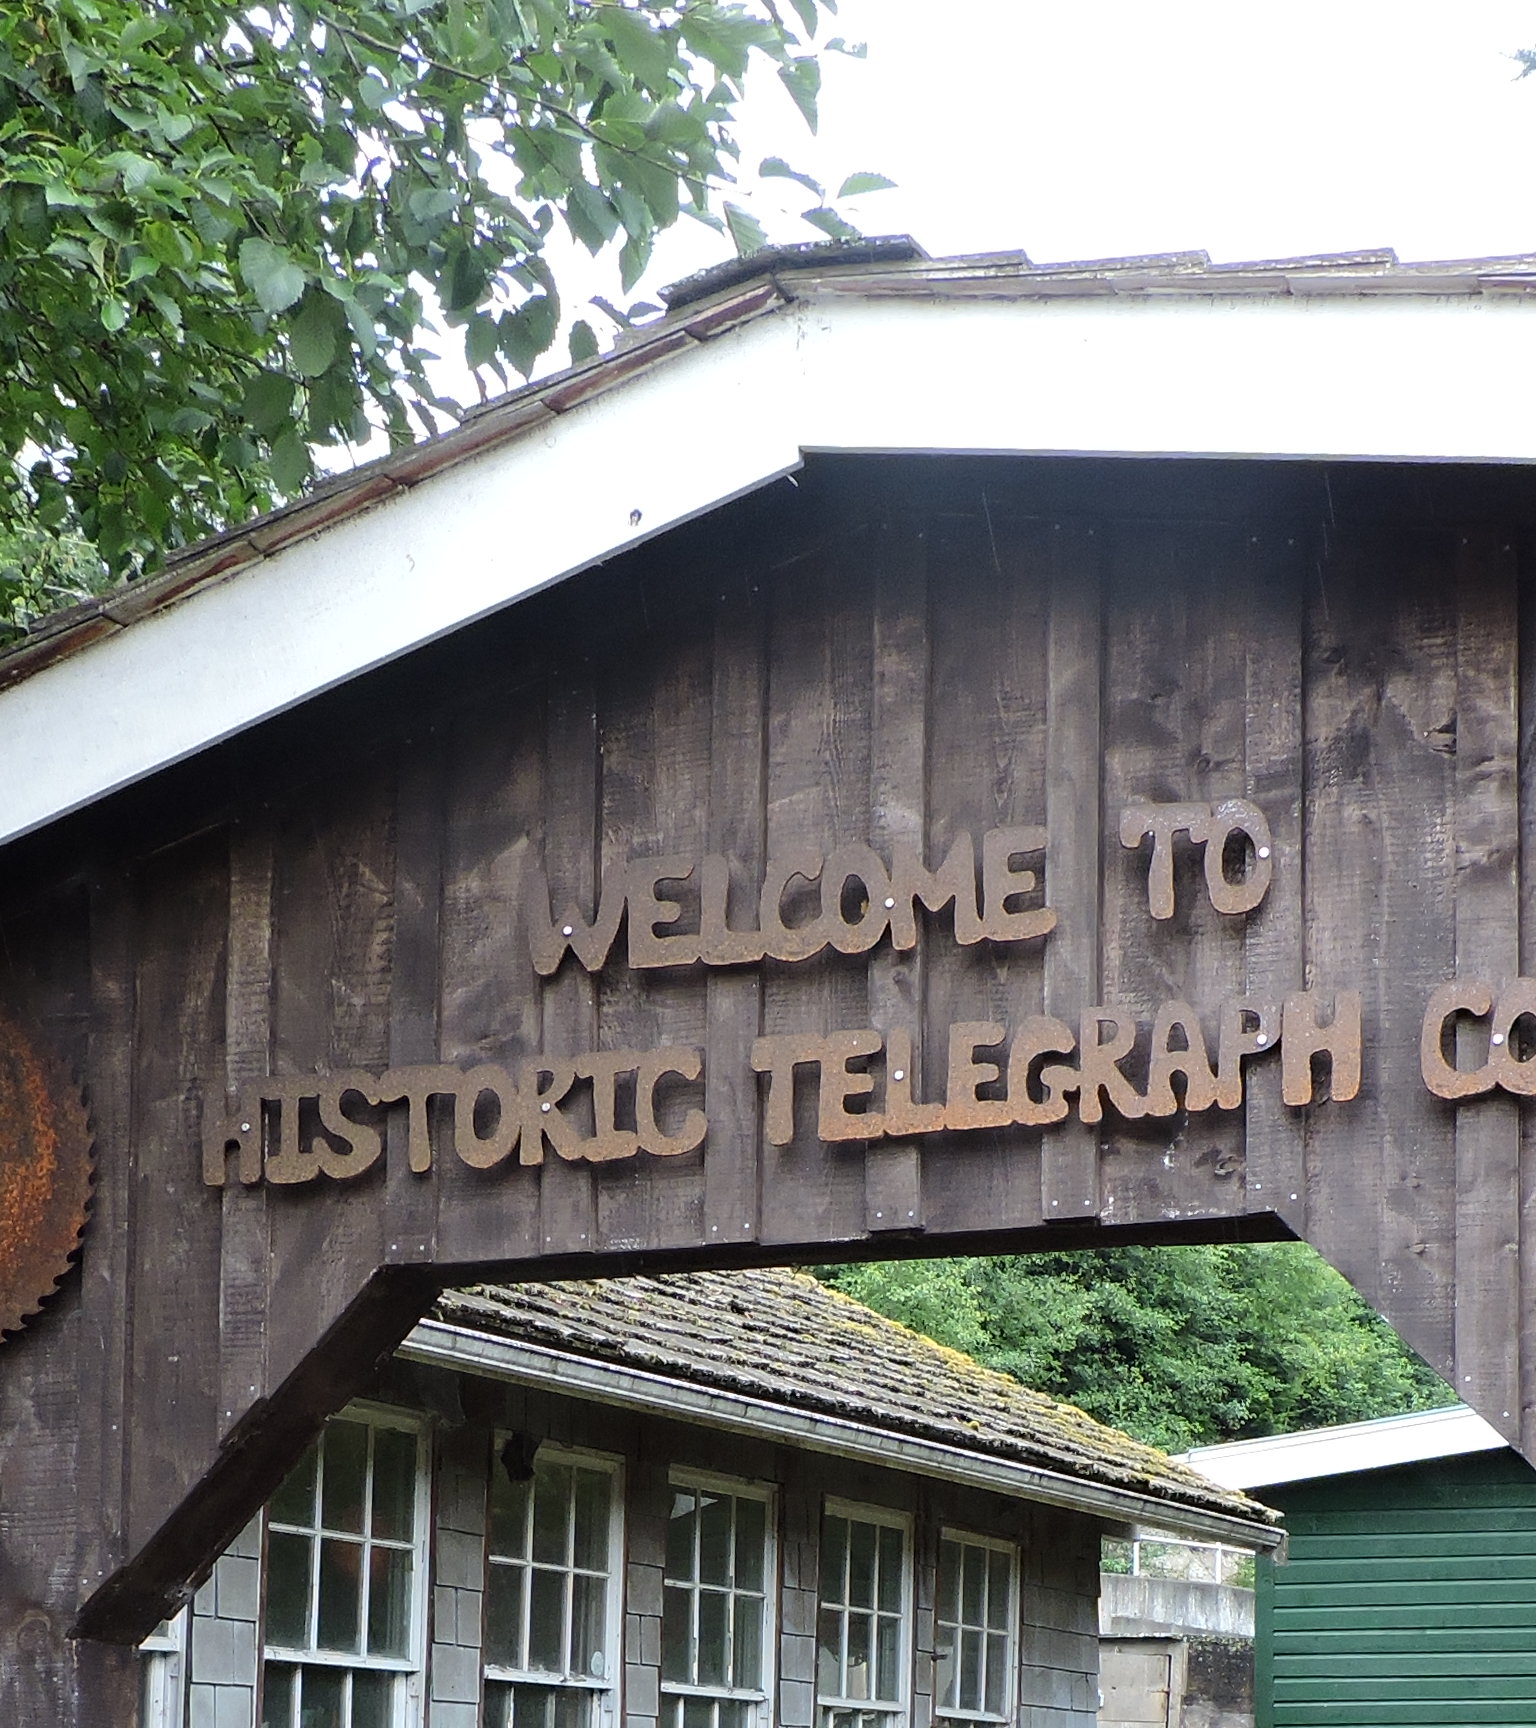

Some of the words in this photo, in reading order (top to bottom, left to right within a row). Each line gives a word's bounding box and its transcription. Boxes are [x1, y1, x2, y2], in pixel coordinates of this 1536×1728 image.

[525, 826, 1057, 975] WELCOME
[1120, 800, 1270, 920] TO
[201, 1048, 708, 1186] HISTORIC
[751, 989, 1363, 1146] TELEGRAPH
